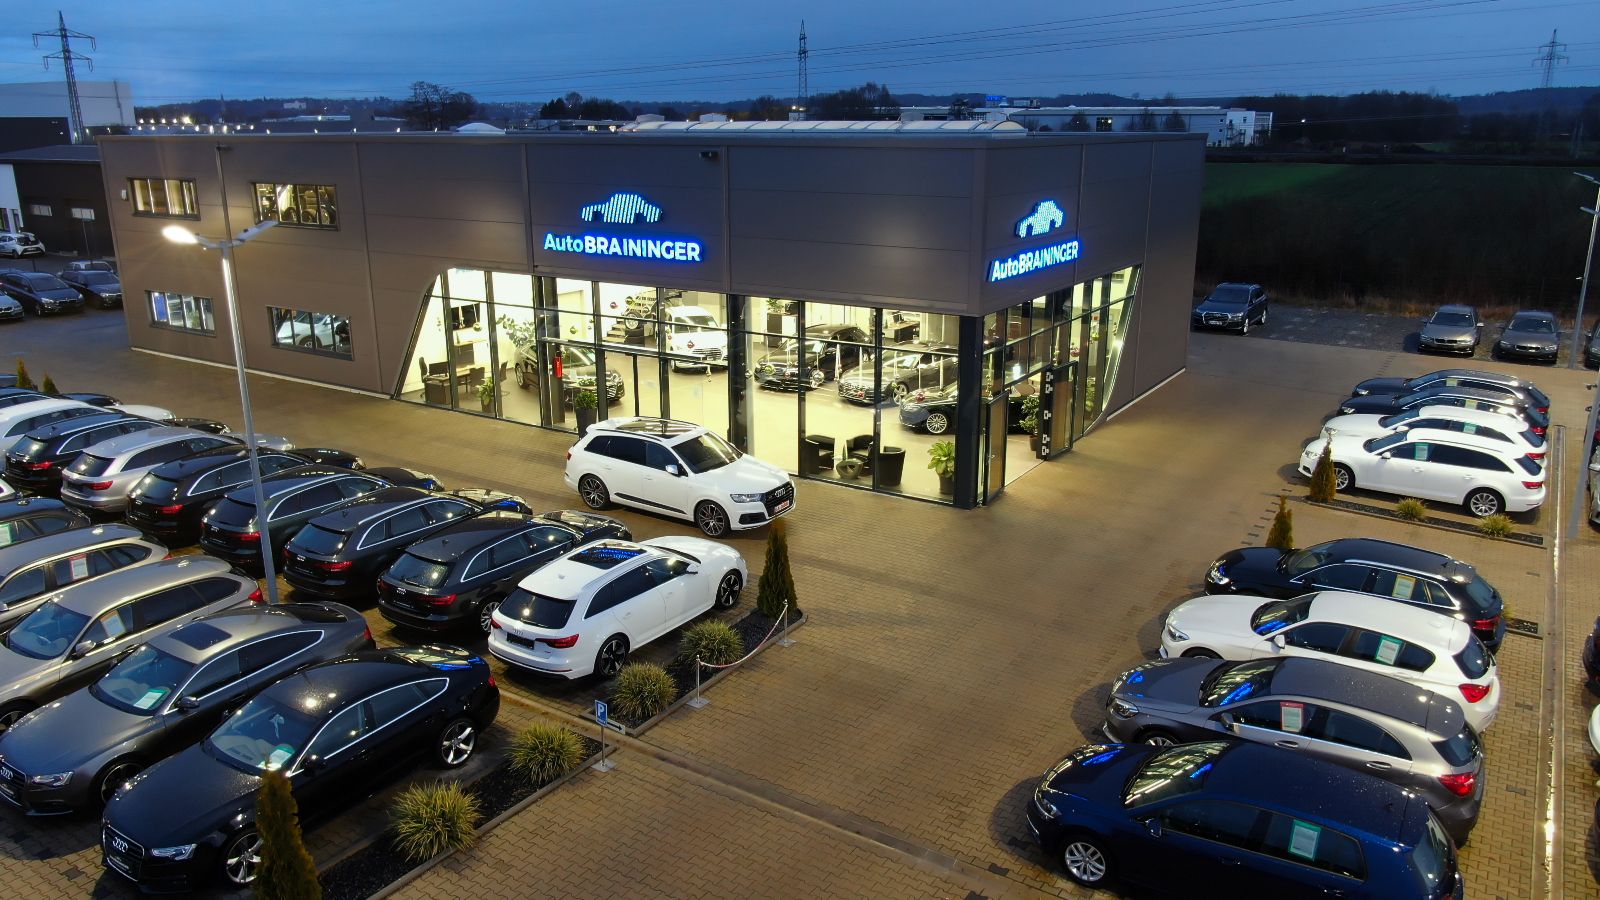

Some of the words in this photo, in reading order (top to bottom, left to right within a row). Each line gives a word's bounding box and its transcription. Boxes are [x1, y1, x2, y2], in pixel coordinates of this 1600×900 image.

[543, 233, 701, 262] AutoBRAININGER
[991, 240, 1079, 282] AutoBRAININGER
[597, 703, 605, 717] P
